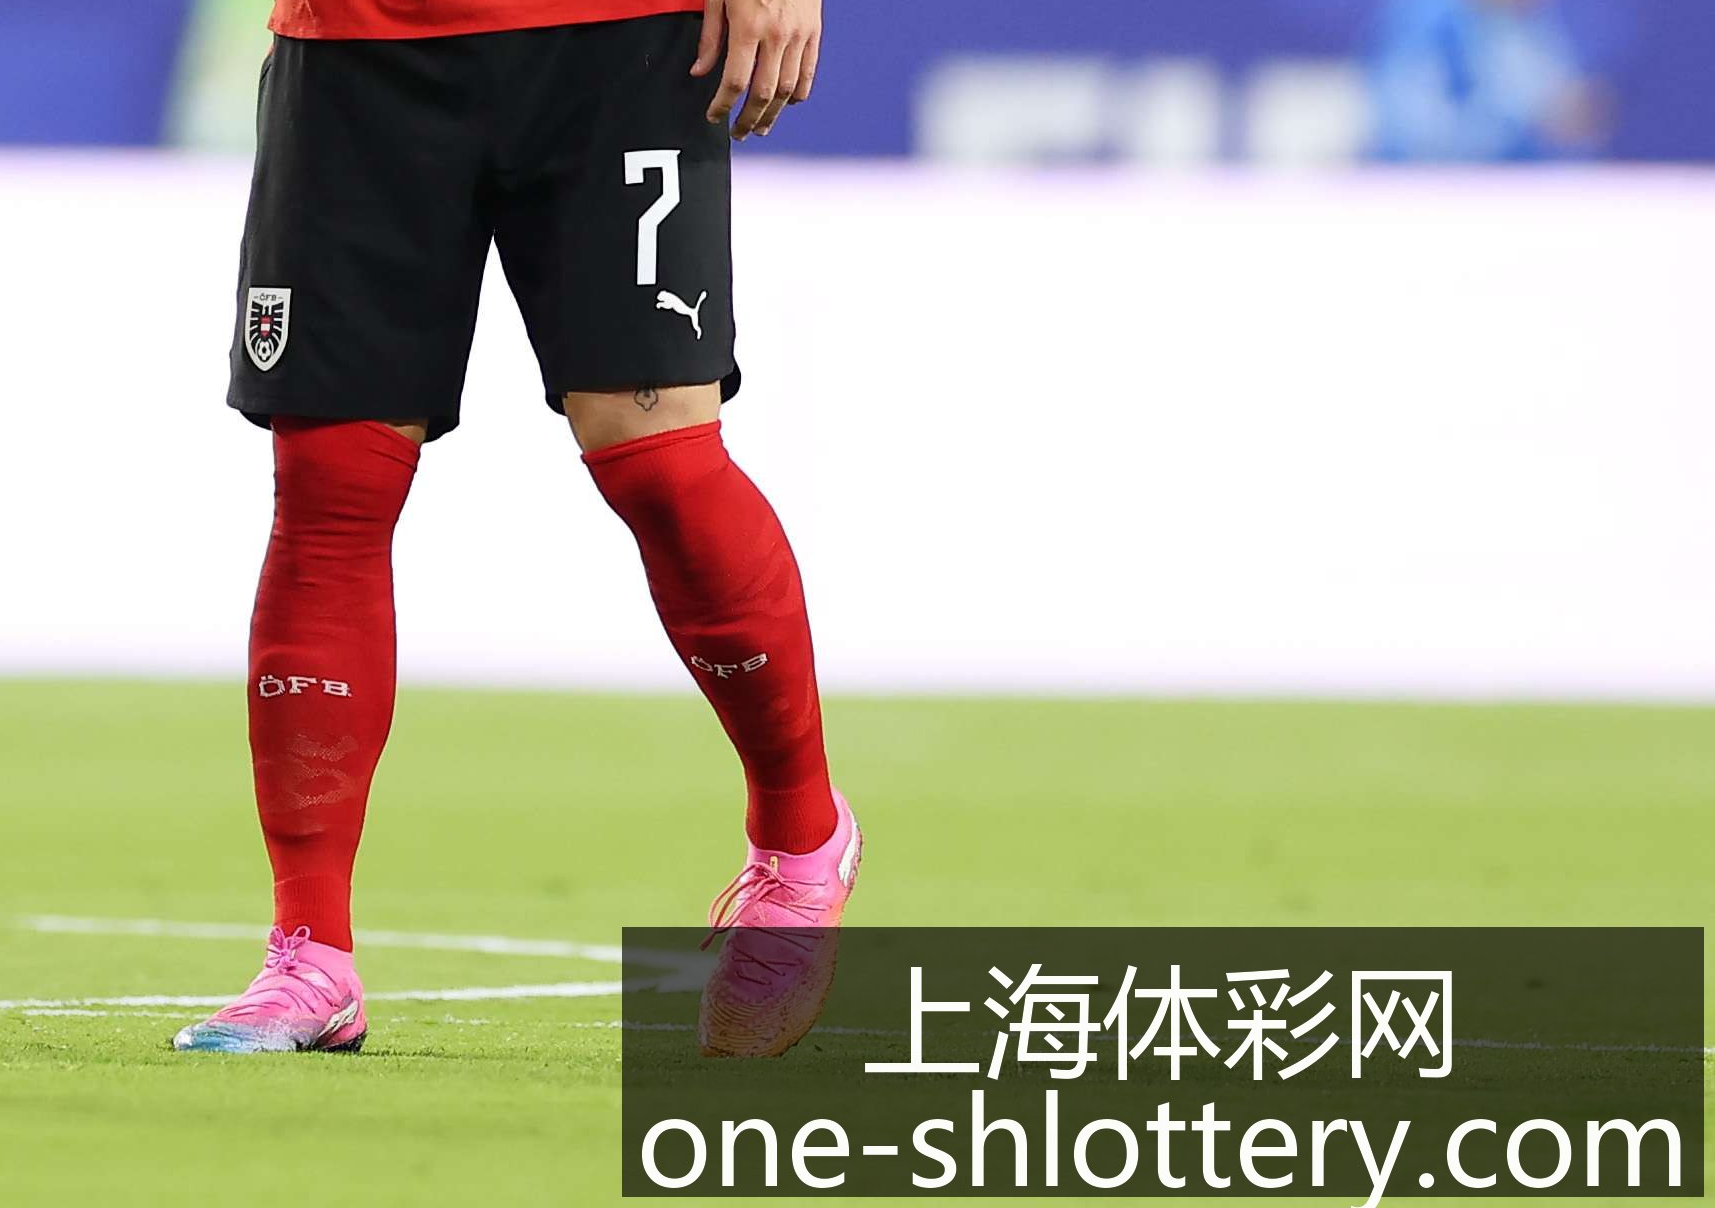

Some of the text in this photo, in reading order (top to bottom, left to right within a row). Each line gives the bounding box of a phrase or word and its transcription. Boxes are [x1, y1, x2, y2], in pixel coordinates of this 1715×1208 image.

[624, 149, 681, 285] 7
[690, 653, 768, 679] ÖFB
[258, 674, 352, 699] ÖFB
